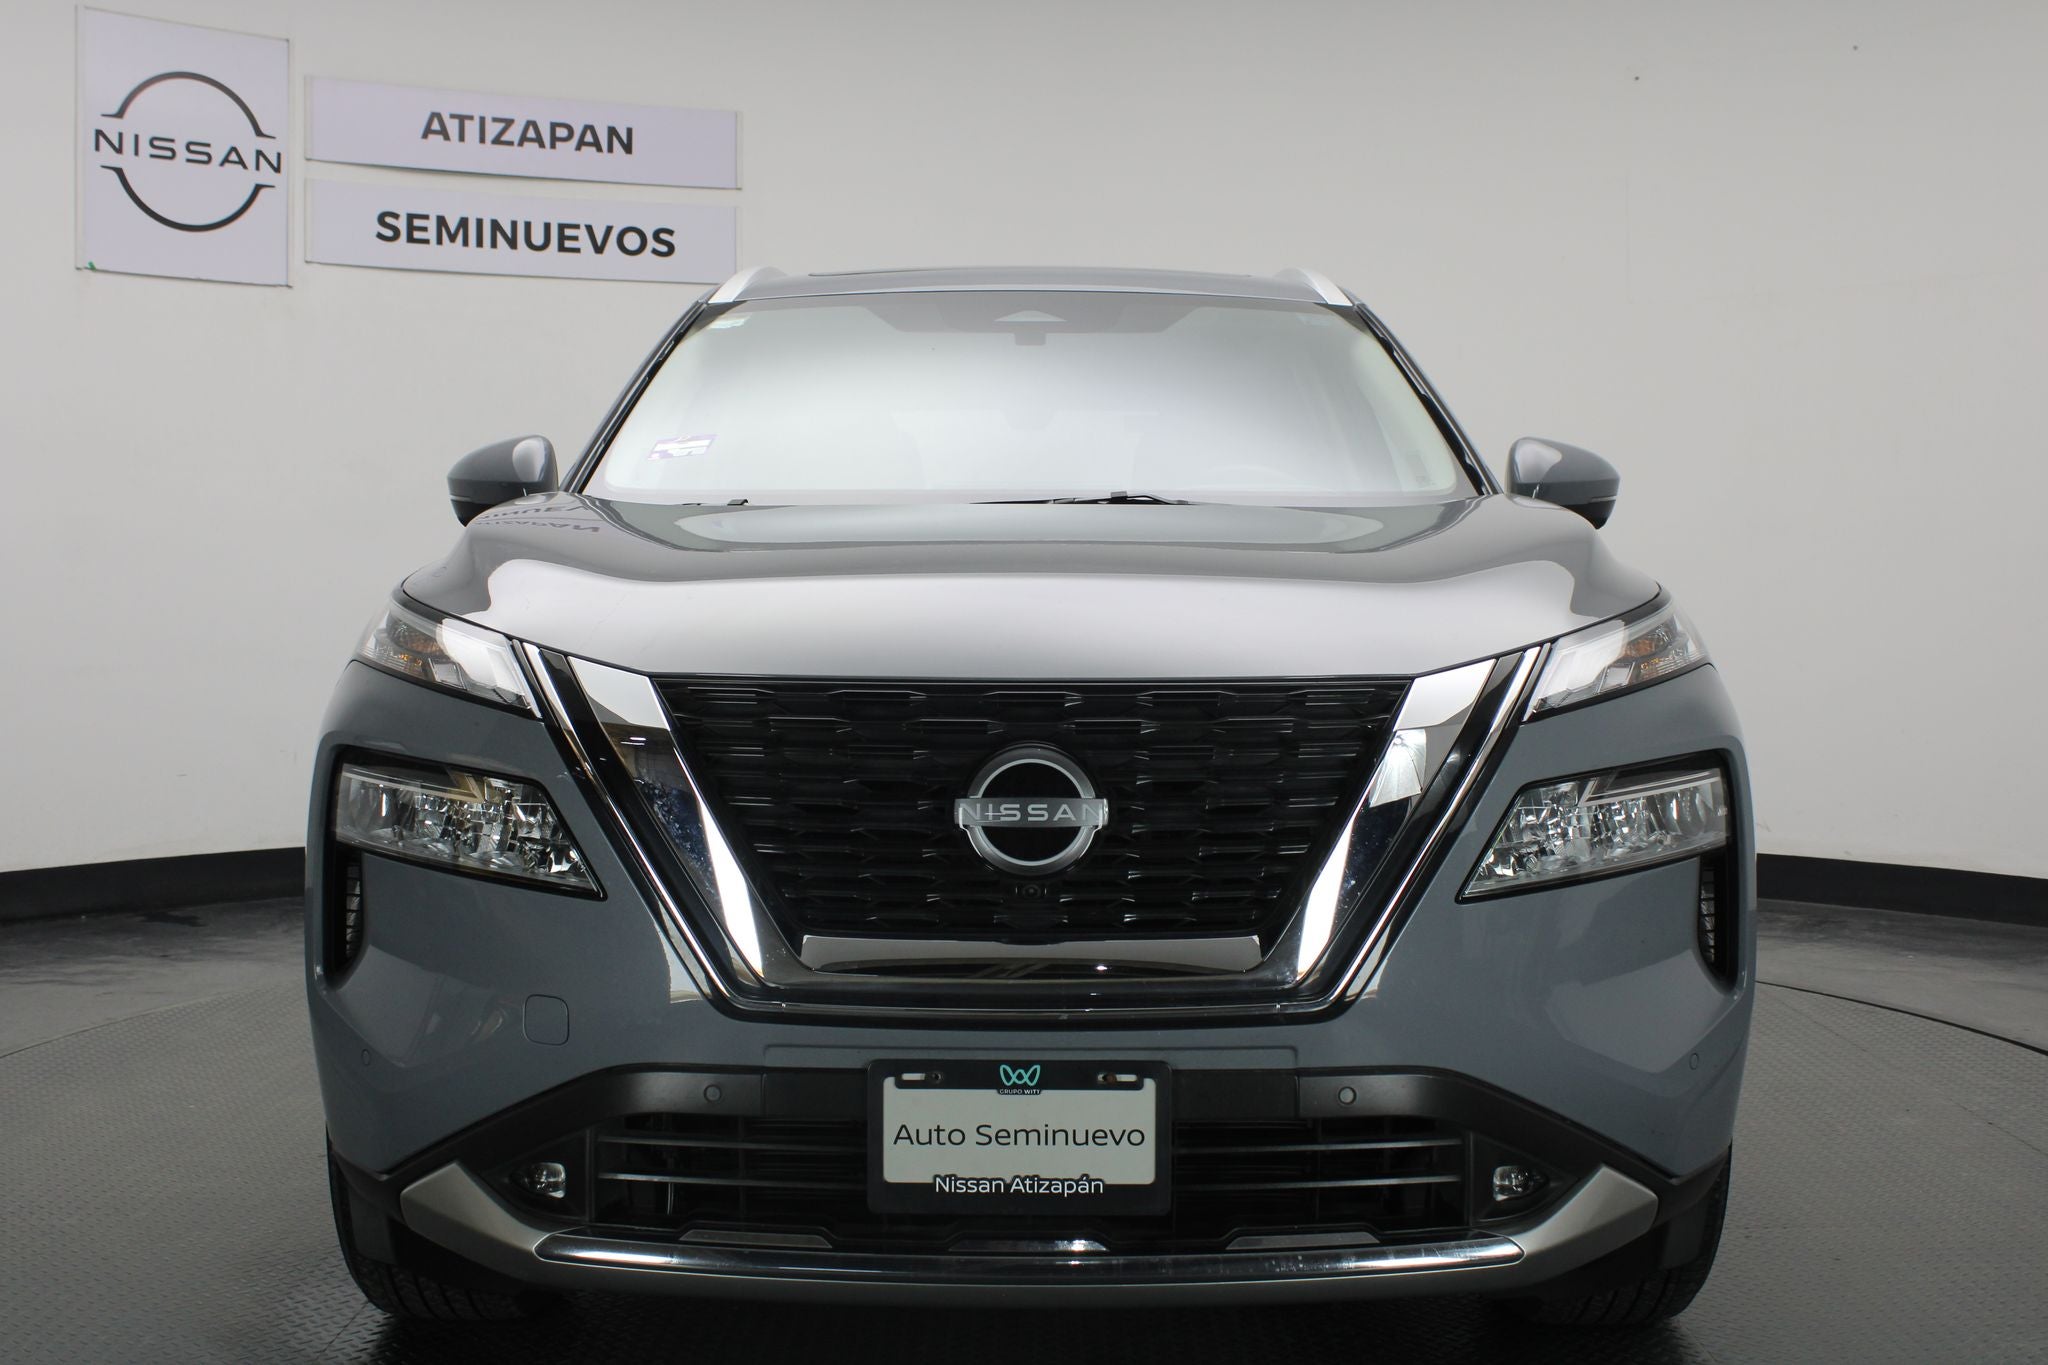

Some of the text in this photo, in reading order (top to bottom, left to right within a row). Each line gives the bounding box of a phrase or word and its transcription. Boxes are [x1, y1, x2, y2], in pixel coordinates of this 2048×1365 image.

[420, 110, 635, 155] ATIZAPAN
[94, 128, 282, 174] NISSAN
[375, 210, 677, 258] SEMINUEVOS
[958, 803, 1104, 823] NISSAN
[893, 1124, 1145, 1146] Auto Seminuevo
[935, 1175, 1104, 1197] Nissan Atizapán
